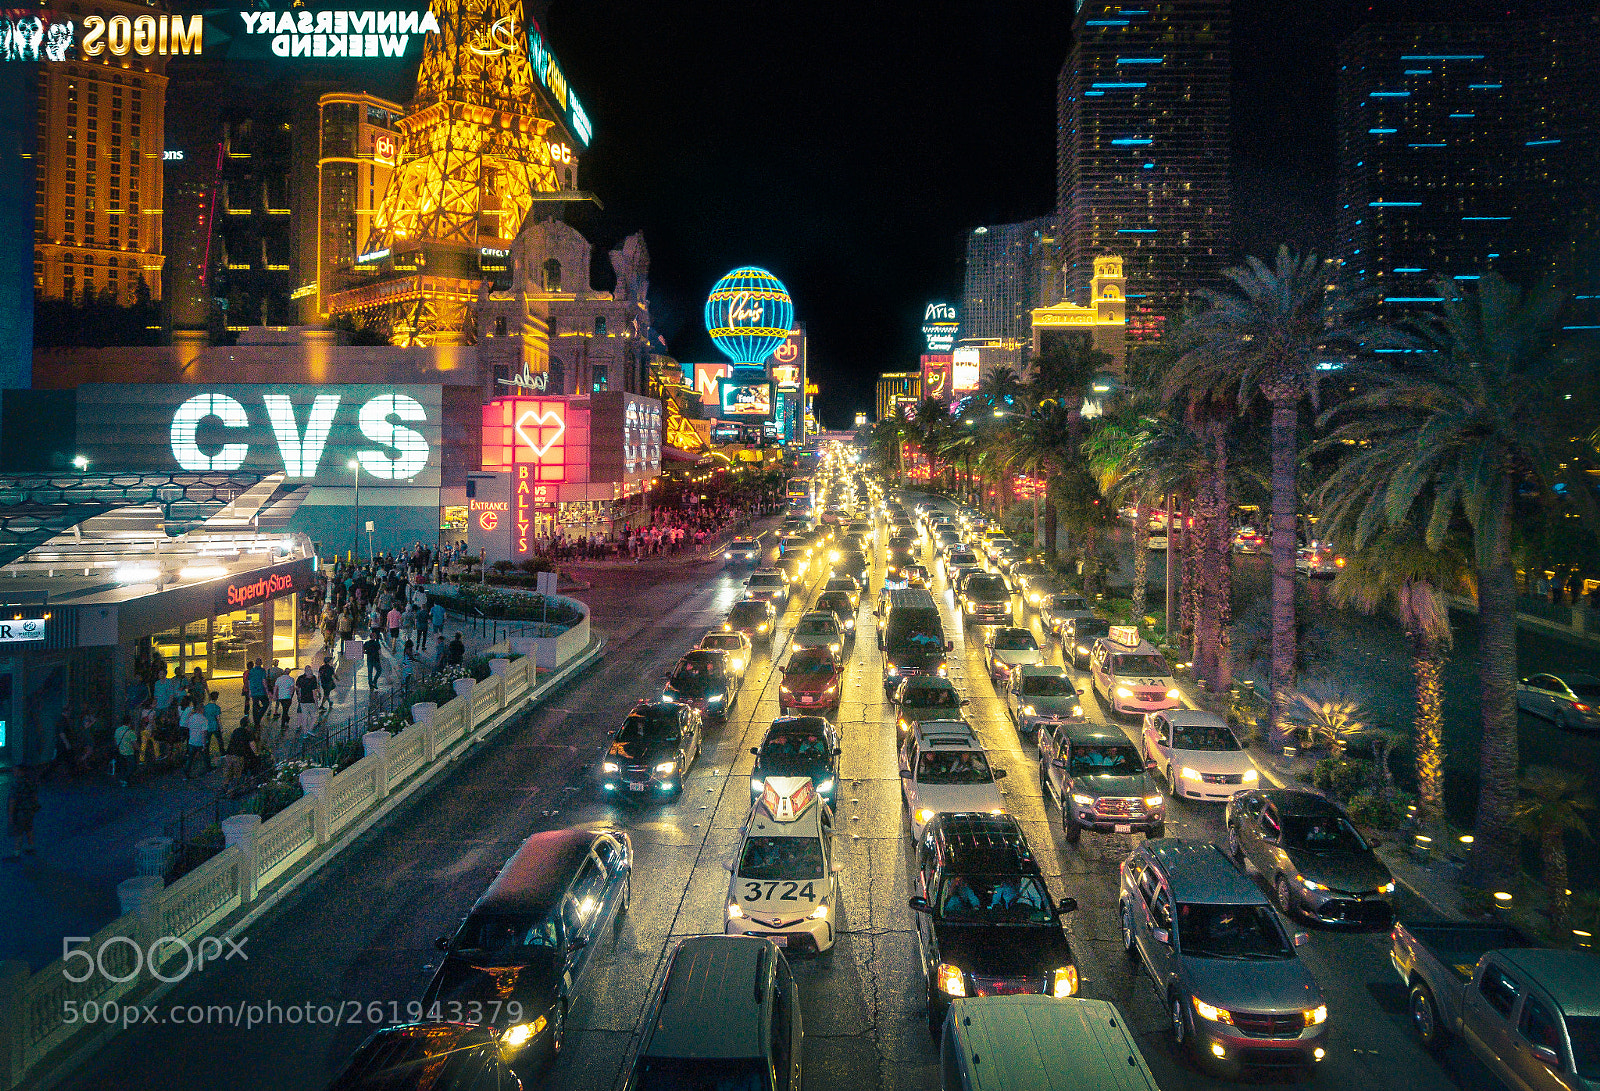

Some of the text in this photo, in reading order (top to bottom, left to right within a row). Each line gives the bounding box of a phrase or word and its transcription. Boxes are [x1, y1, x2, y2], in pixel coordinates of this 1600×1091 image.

[729, 291, 763, 331] Paris
[924, 303, 956, 320] Aria
[170, 392, 430, 480] CVS
[470, 499, 509, 511] ENTRANCE
[517, 466, 530, 552] BALLYS
[744, 881, 816, 903] 3724
